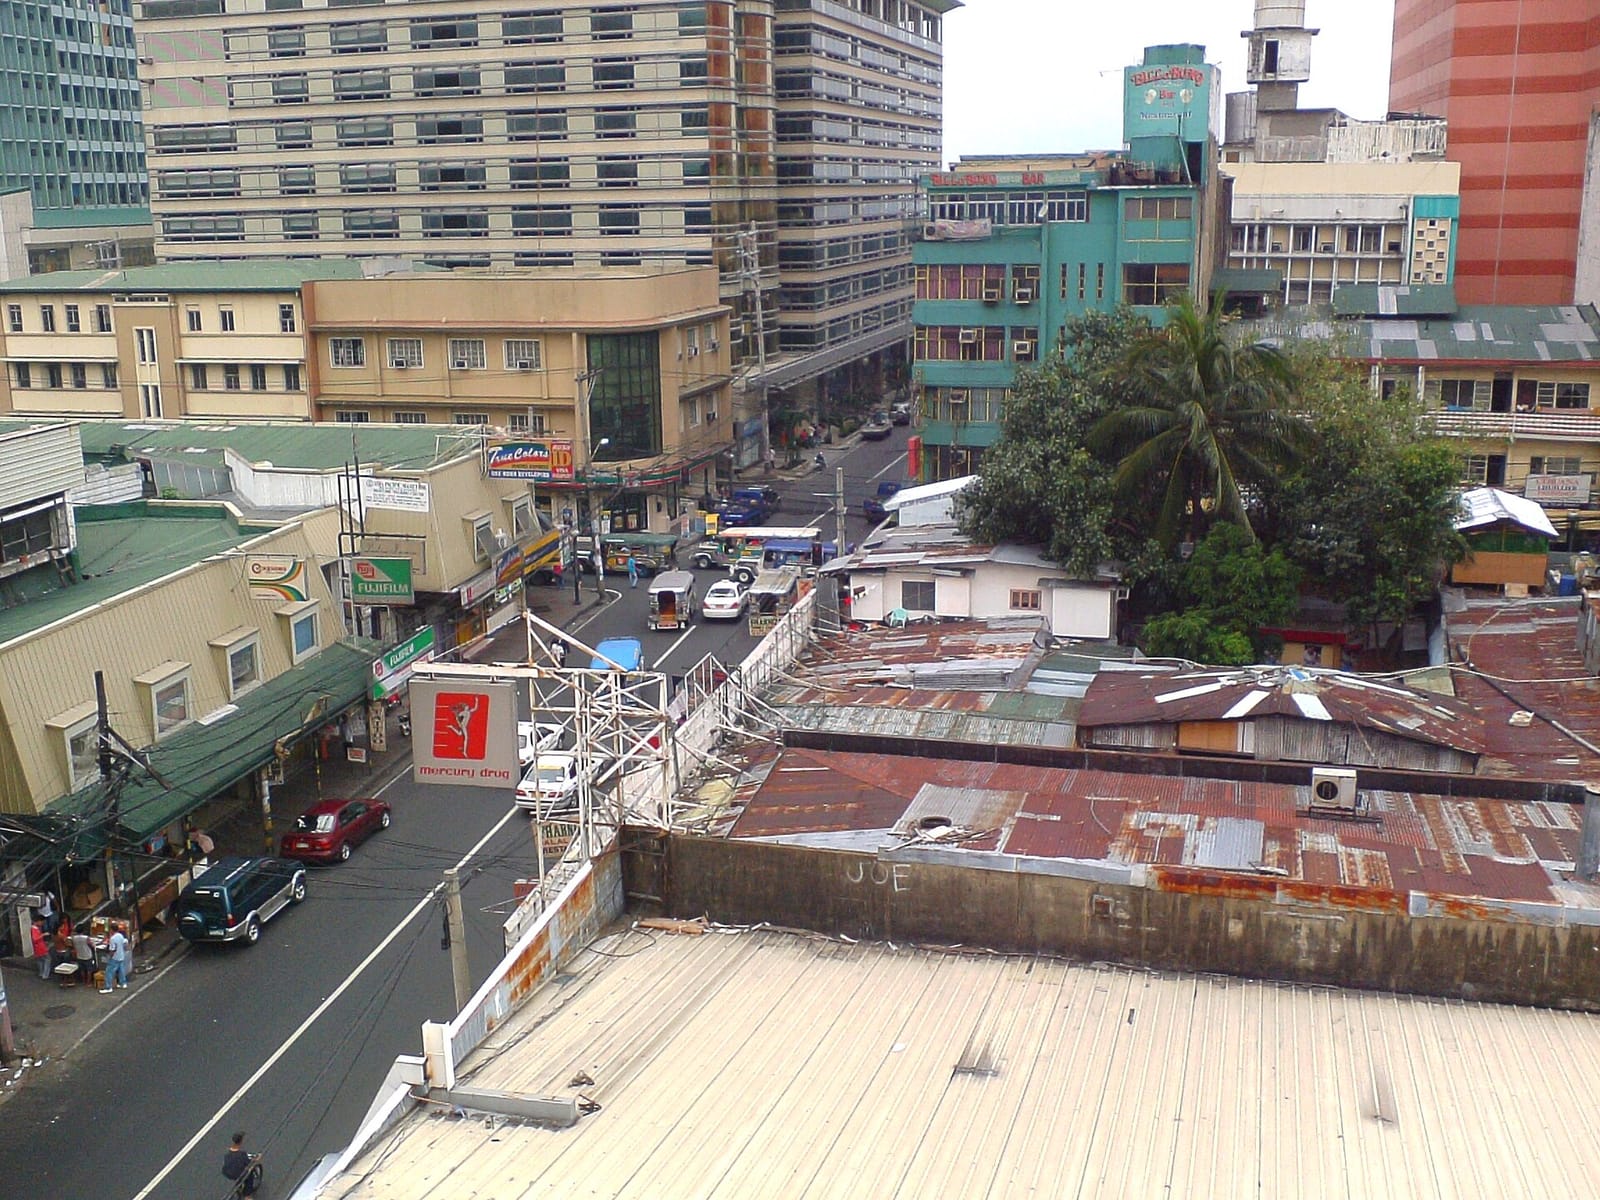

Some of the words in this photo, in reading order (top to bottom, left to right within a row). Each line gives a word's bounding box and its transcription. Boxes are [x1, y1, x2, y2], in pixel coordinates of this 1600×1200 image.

[1022, 172, 1045, 185] BAR
[488, 446, 514, 464] True
[514, 447, 549, 460] Colors
[552, 450, 572, 466] ID
[358, 583, 408, 593] FUJIFILM
[420, 766, 475, 778] mercury
[480, 767, 510, 779] drug
[846, 860, 911, 892] JOE
